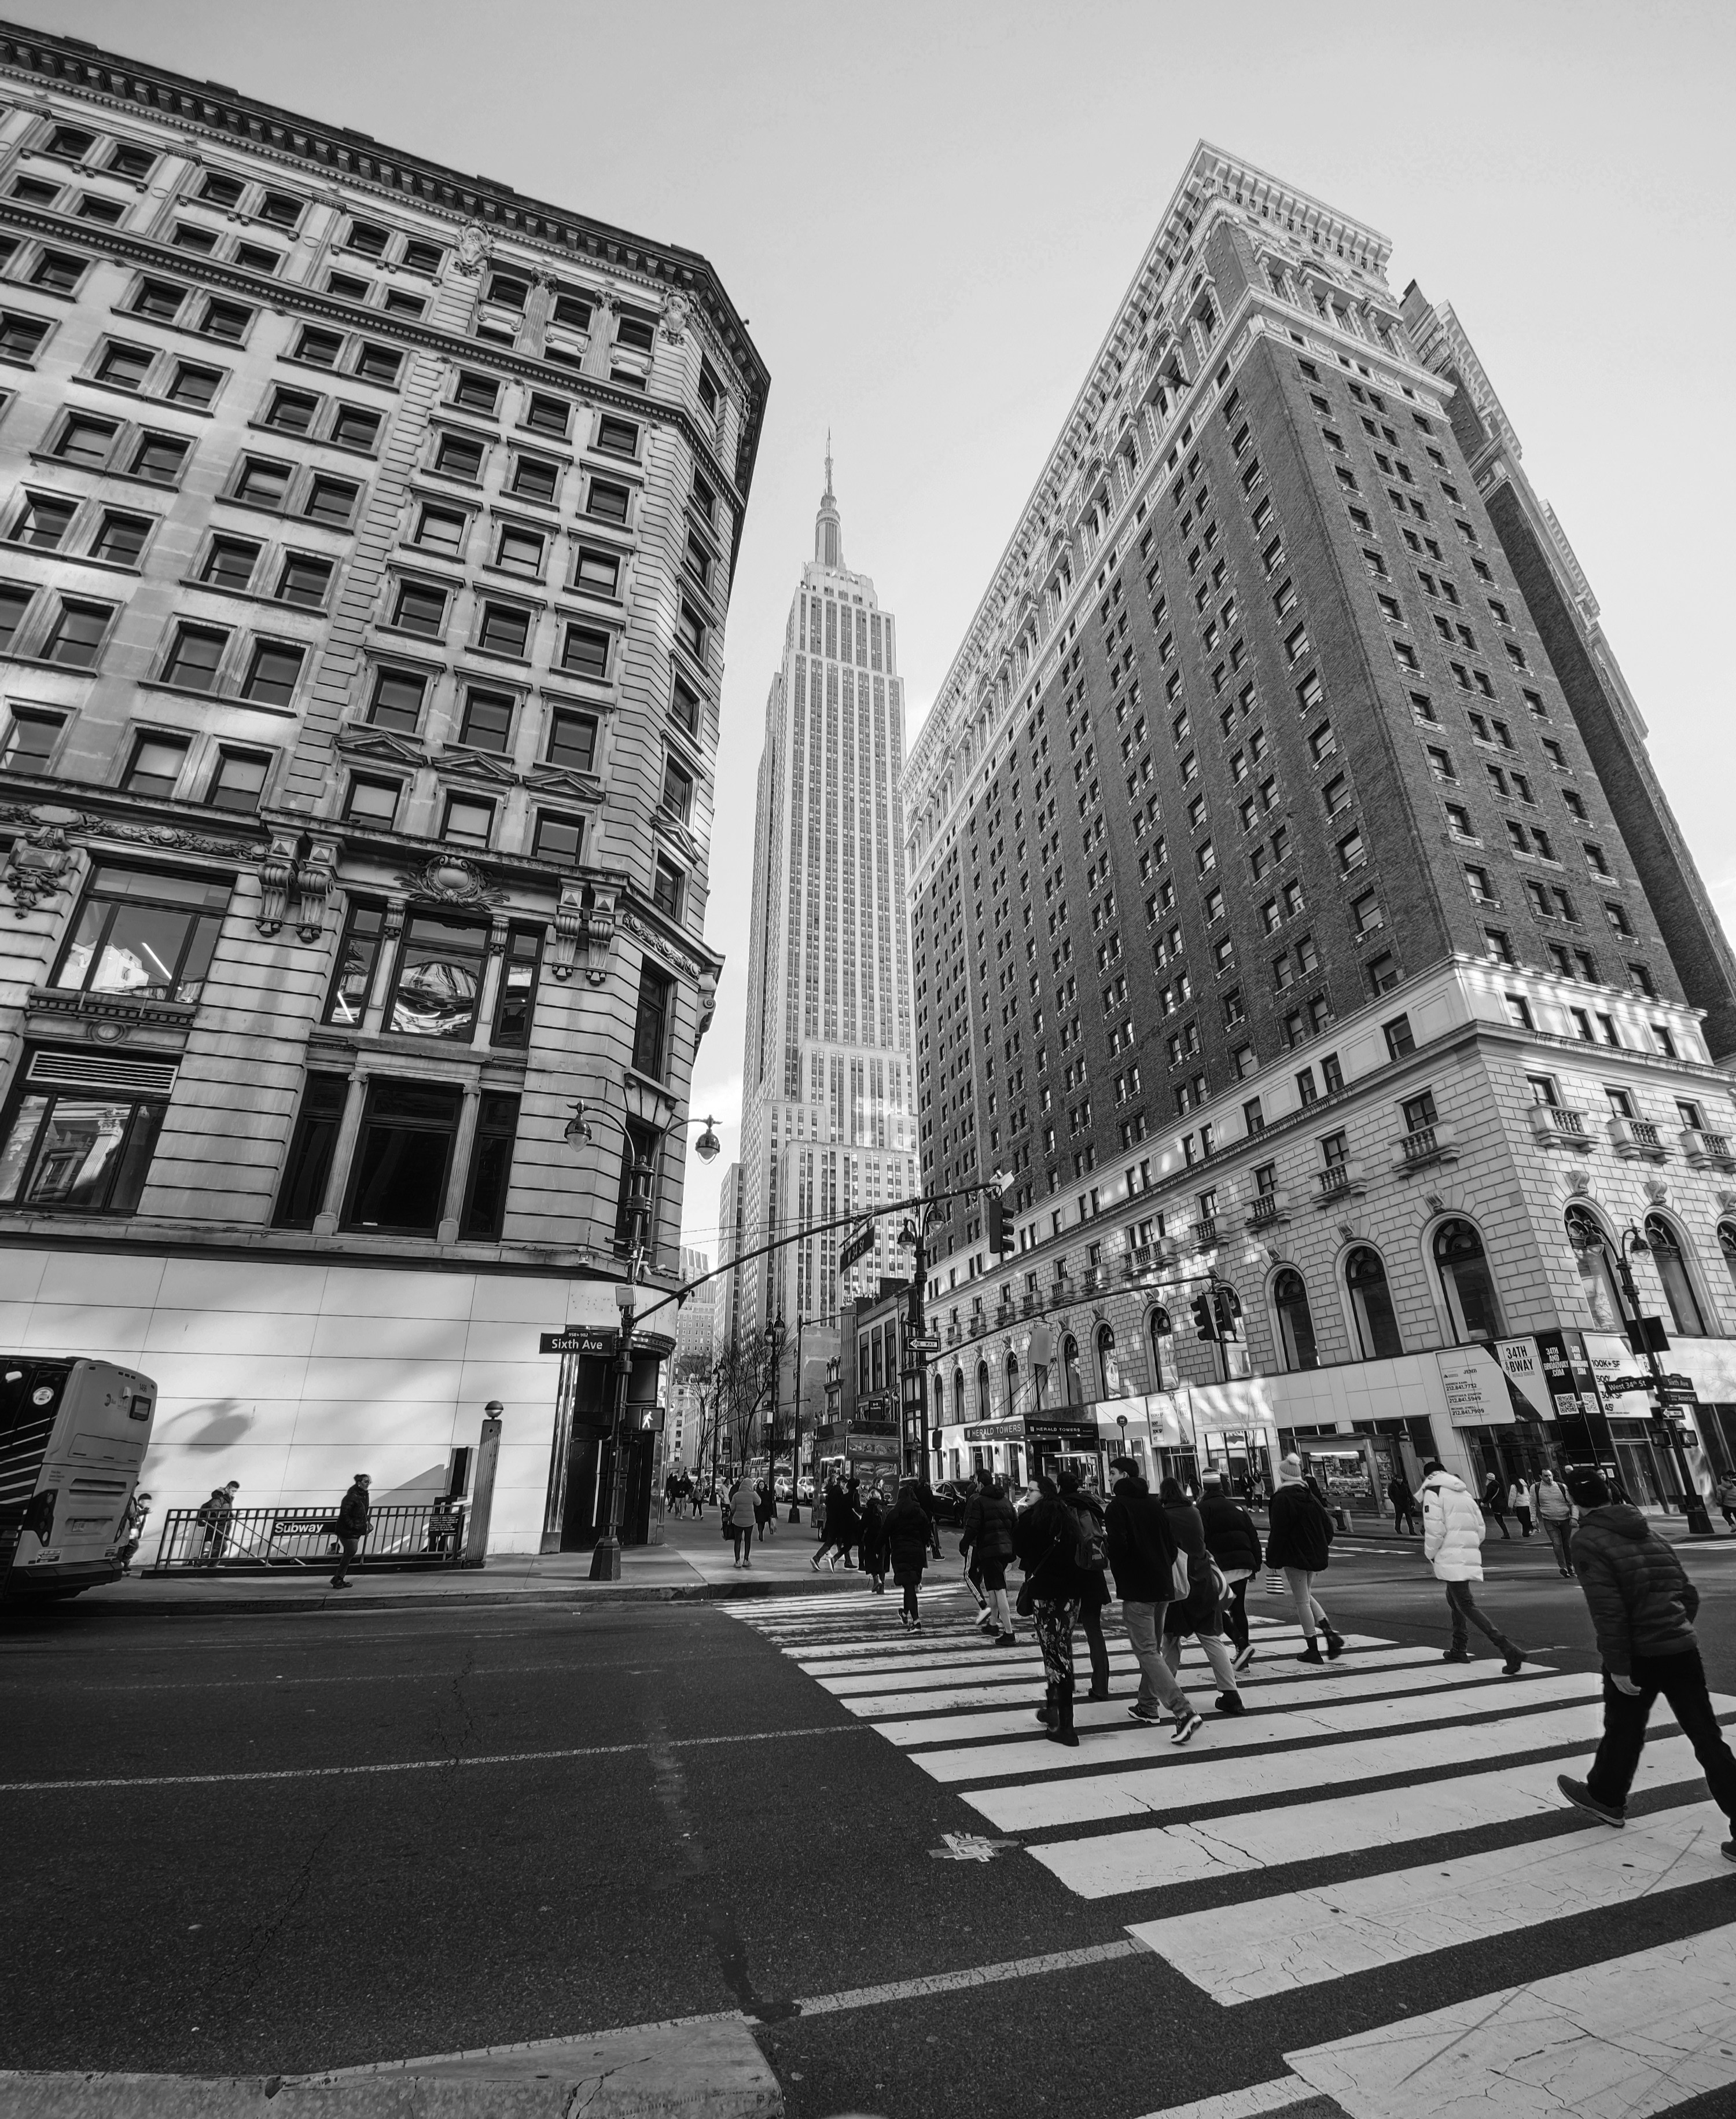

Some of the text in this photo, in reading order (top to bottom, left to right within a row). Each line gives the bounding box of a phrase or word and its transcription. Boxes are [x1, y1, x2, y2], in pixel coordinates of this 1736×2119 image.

[847, 1239, 865, 1264] W 34 St
[551, 1338, 603, 1350] Sixth Ave
[1506, 1345, 1528, 1359] 34TH
[1546, 1347, 1559, 1355] 34TH
[1549, 1354, 1560, 1362] AND
[1543, 1360, 1569, 1371] BROADWAY
[1552, 1368, 1565, 1377] .COM
[1625, 1380, 1637, 1389] 34th
[972, 1424, 1021, 1437] HERALD TOWERS
[274, 1522, 323, 1533] Subway
